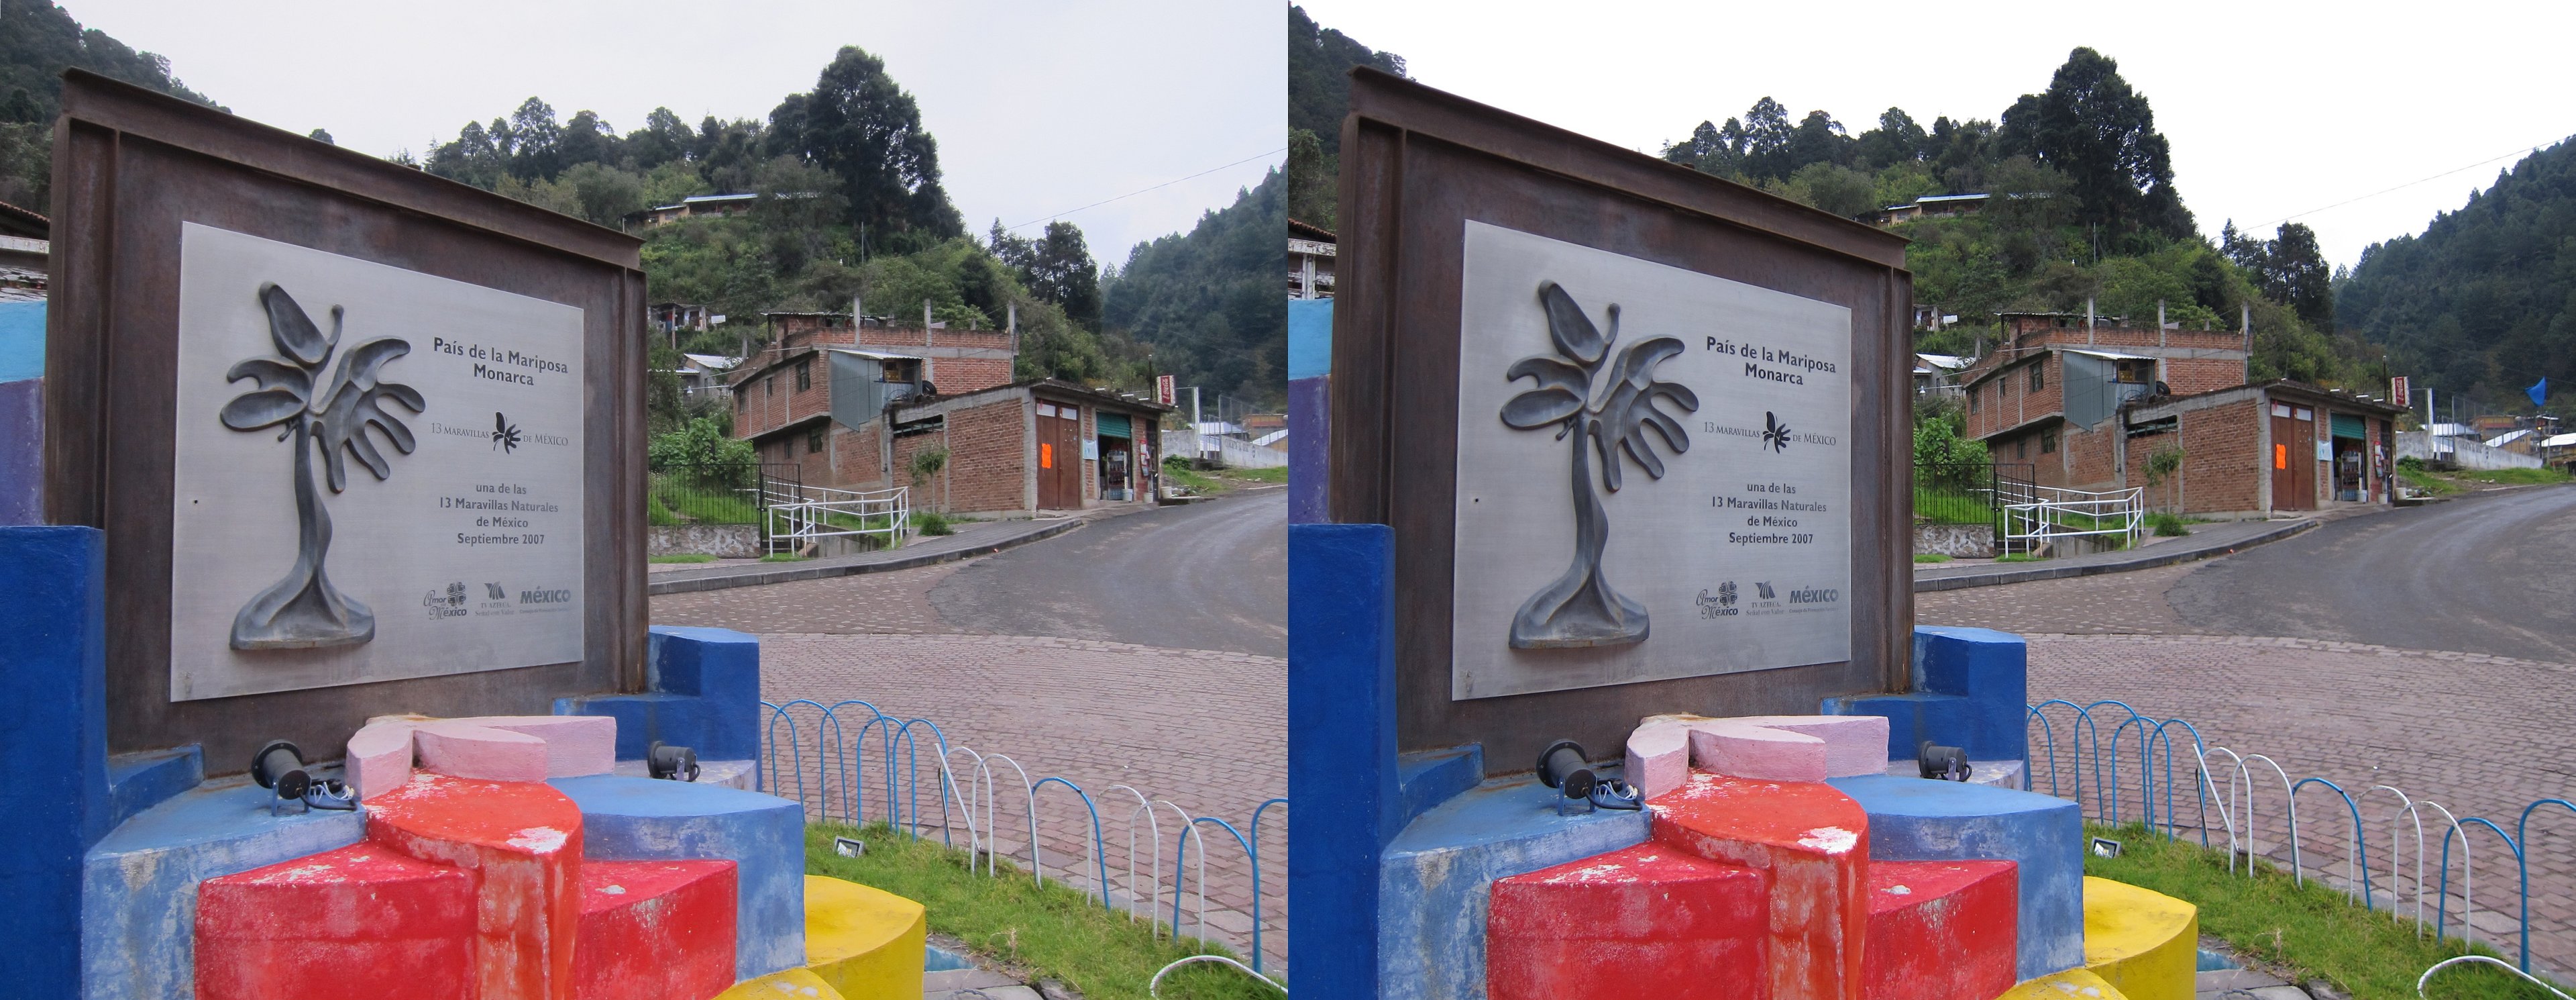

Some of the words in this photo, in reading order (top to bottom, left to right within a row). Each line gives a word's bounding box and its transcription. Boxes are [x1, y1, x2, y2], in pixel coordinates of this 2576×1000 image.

[434, 336, 464, 356] País
[469, 344, 486, 360] de
[491, 347, 503, 362] la
[508, 350, 568, 374] Mariposa
[1707, 336, 1735, 355] País
[1741, 344, 1757, 359] de
[1762, 346, 1774, 362] la
[1778, 350, 1836, 373] Mariposa
[474, 362, 534, 386] Monarca
[1745, 362, 1803, 385] Monarca
[431, 422, 441, 434] 13
[443, 426, 489, 439] MARAVILLAS
[523, 435, 532, 443] DE
[535, 434, 568, 446] MÉXICO
[1704, 421, 1714, 433] 13
[1716, 426, 1760, 438] MARAVILLAS
[1792, 434, 1801, 442] DE
[1804, 433, 1836, 446] MÉXICO
[476, 484, 494, 493] una
[498, 483, 510, 494] de
[513, 484, 527, 495] las
[1747, 483, 1765, 493] una
[1768, 483, 1780, 493] de
[1783, 483, 1796, 494] las
[439, 497, 451, 508] 13
[455, 498, 508, 511] Maravillas
[511, 501, 559, 513] Naturales
[1712, 497, 1723, 507] 13
[1727, 497, 1778, 510] Maravillas
[1781, 500, 1827, 512] Naturales
[476, 516, 489, 527] de
[492, 517, 528, 528] México
[1748, 516, 1760, 526] de
[1763, 516, 1798, 528] México
[458, 533, 519, 547] Septiembre
[522, 534, 545, 545] 2007
[1729, 532, 1788, 546] Septiembre
[1792, 534, 1813, 544] 2007
[423, 590, 447, 606] Amor
[1696, 589, 1718, 605] Amor
[429, 605, 467, 620] México
[1701, 605, 1738, 619] México
